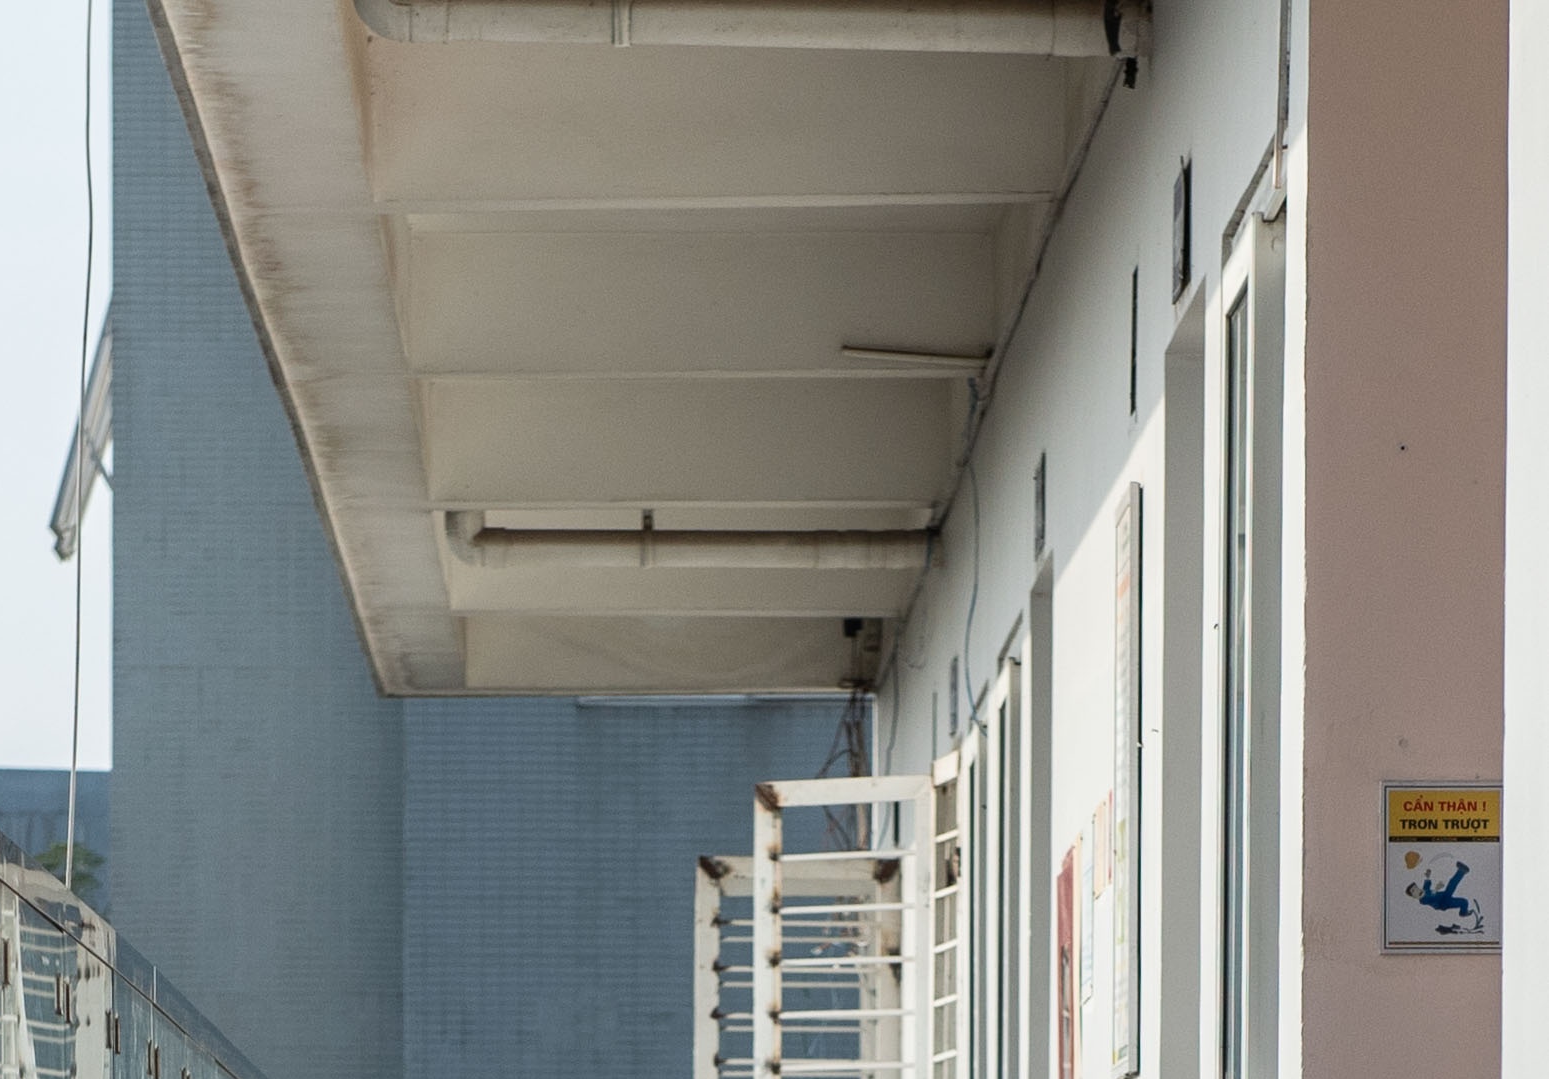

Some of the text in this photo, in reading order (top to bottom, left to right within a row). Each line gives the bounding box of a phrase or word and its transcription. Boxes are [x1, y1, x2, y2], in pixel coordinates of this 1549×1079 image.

[1438, 798, 1478, 815] THẬN
[1482, 801, 1487, 812] !
[1442, 817, 1490, 833] TRƯỢT
